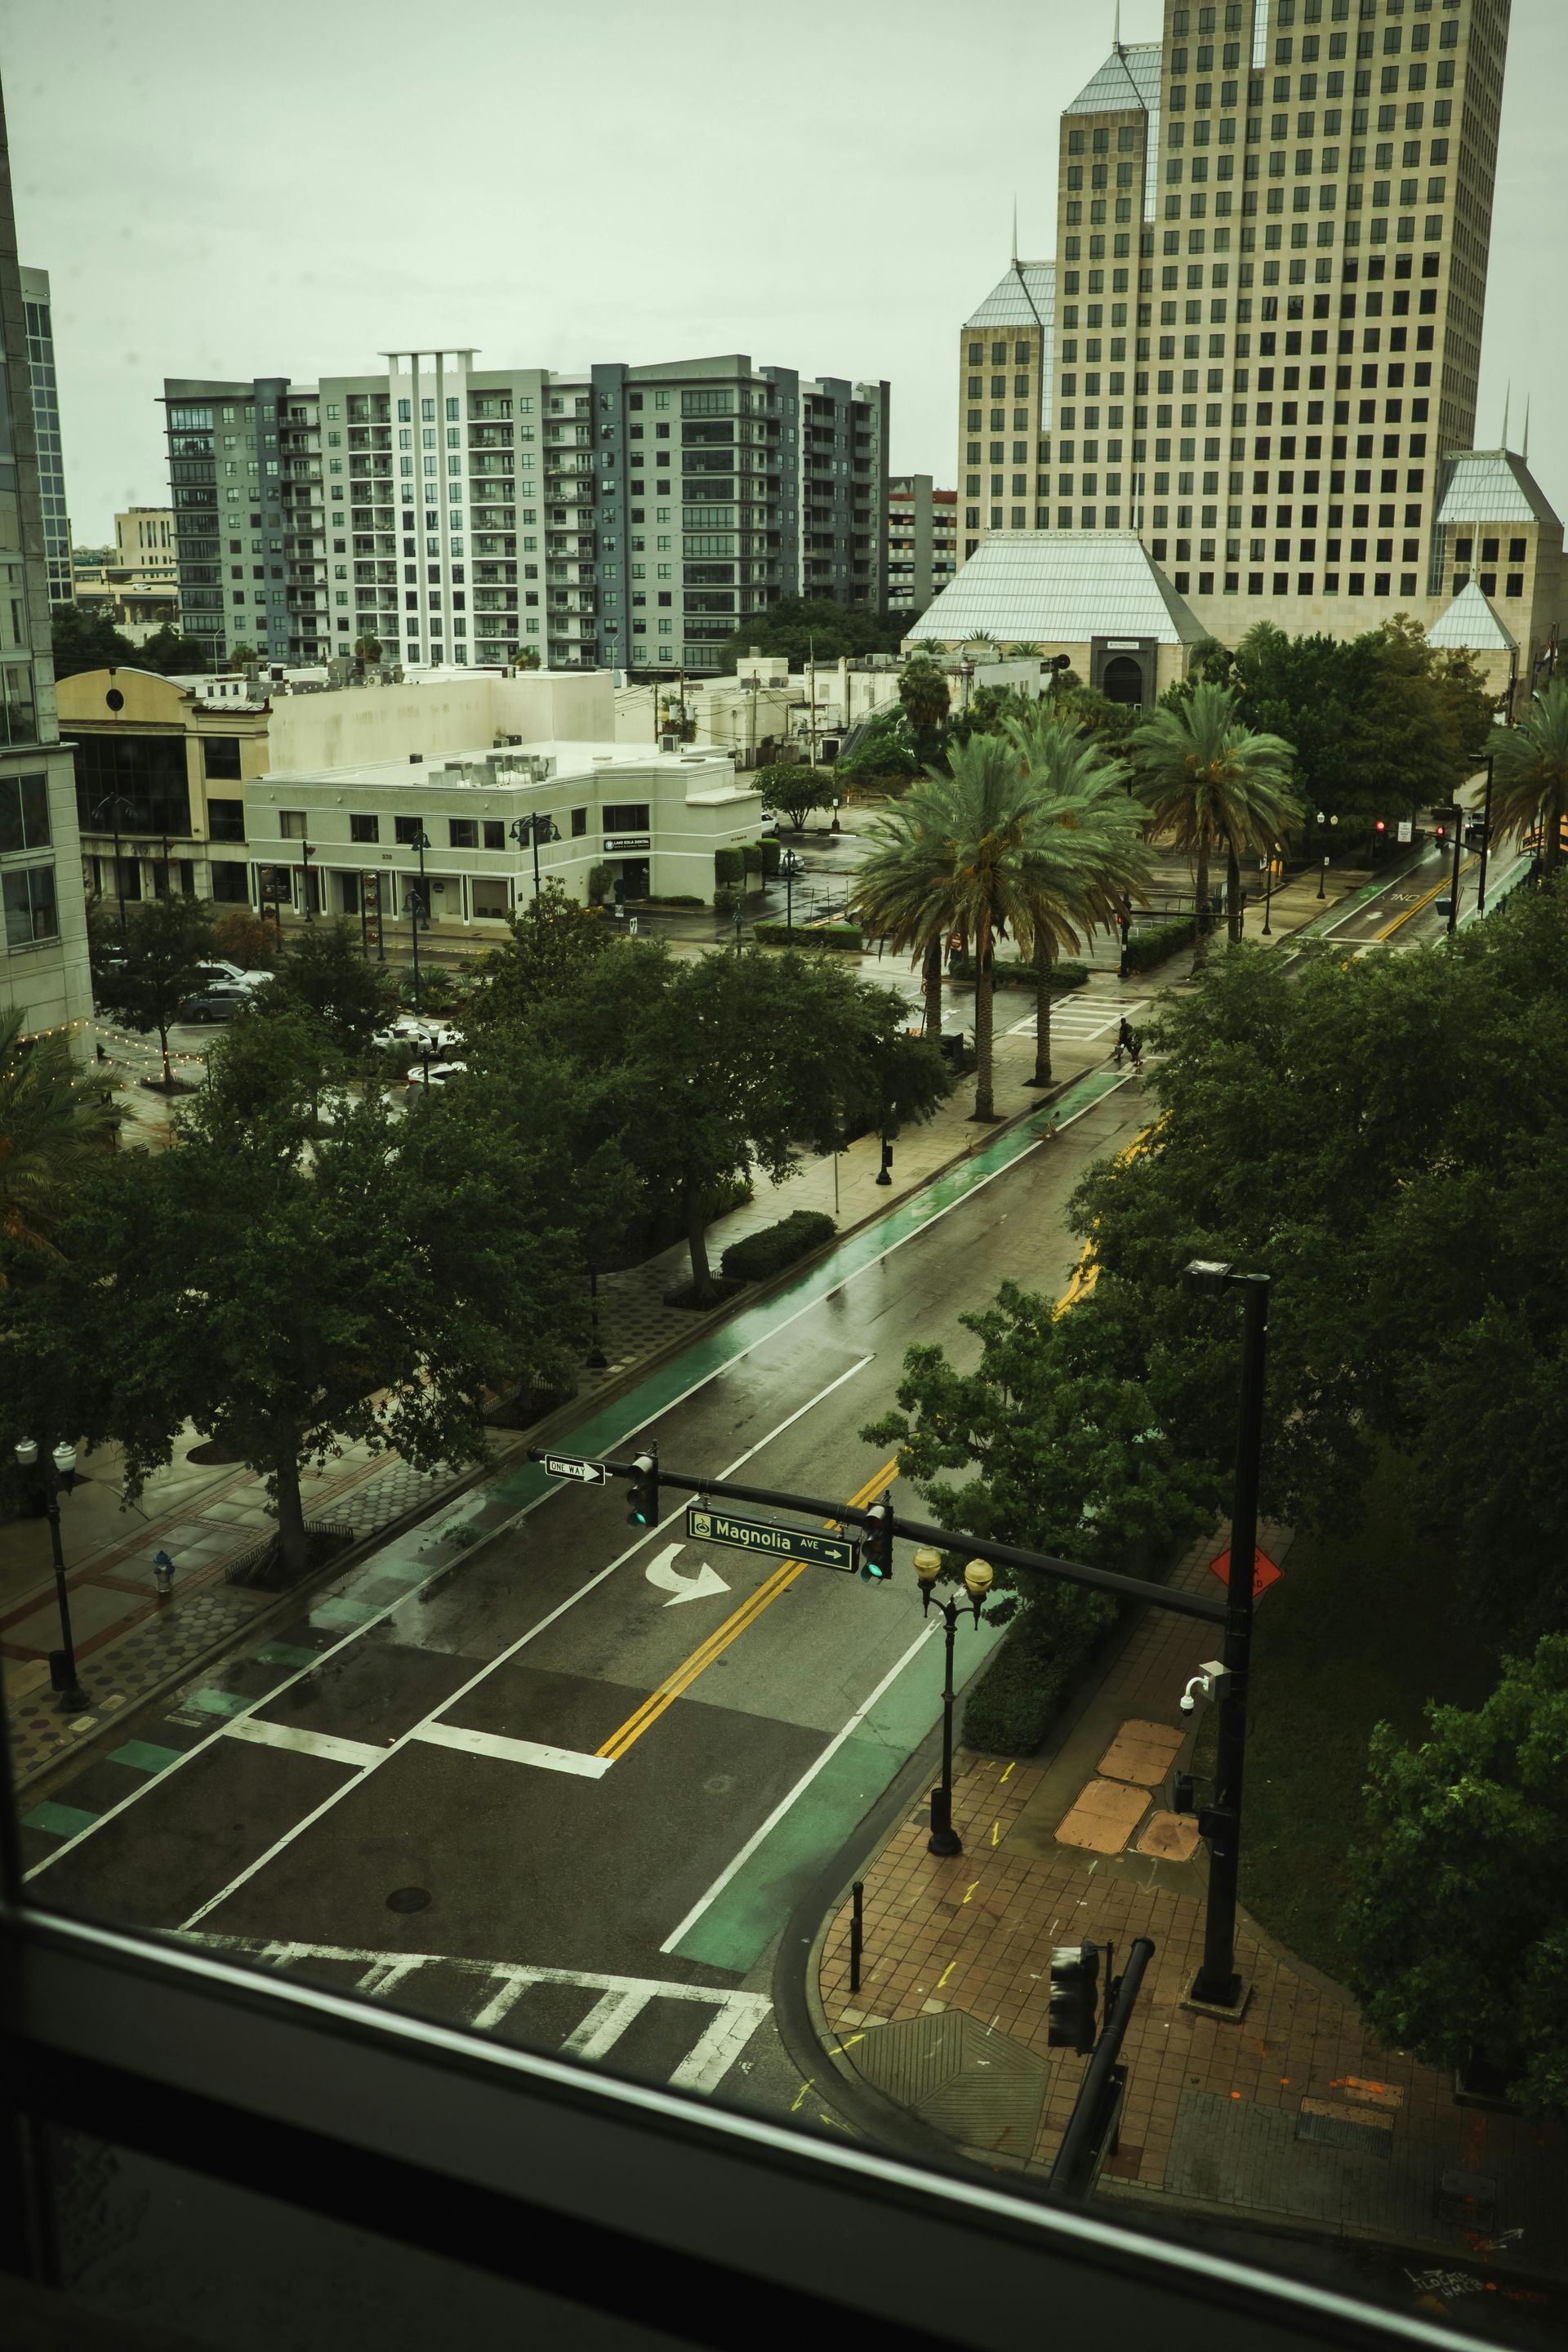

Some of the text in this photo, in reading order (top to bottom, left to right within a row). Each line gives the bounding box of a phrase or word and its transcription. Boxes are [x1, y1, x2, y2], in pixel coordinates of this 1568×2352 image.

[549, 1463, 586, 1475] ONE WAY
[716, 1520, 819, 1550] Magnolia AVE
